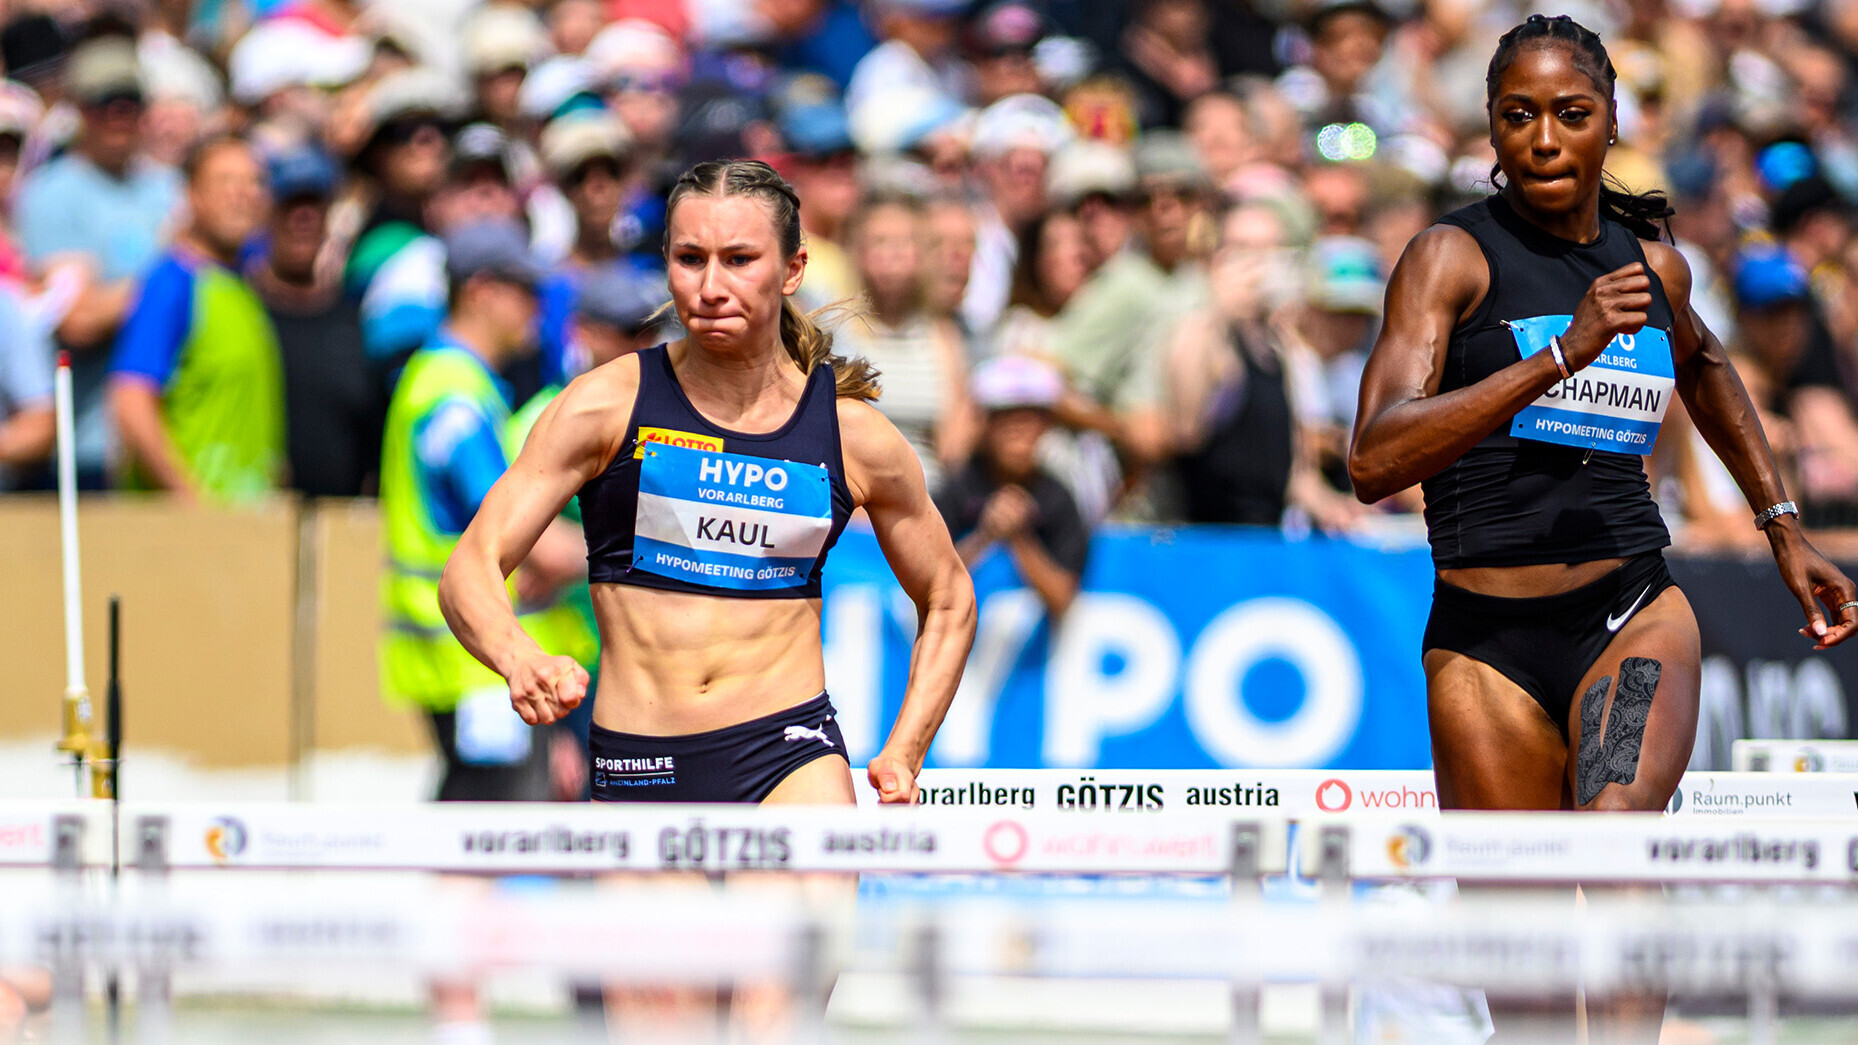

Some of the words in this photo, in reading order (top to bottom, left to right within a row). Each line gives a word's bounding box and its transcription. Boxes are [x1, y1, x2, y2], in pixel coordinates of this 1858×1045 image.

[1594, 354, 1637, 369] ARLBERG
[664, 435, 717, 452] LOTTO
[1536, 418, 1614, 440] HYPOMEETING
[1616, 429, 1647, 444] GÖTZIS
[699, 457, 788, 491] HYPO
[697, 488, 784, 509] VORARLBERG
[696, 516, 775, 549] KAUL
[656, 553, 754, 580] HYPOMEETING
[757, 566, 796, 580] GÖTZIS
[595, 756, 674, 771] SPORTHILFE
[918, 782, 1035, 809] orarlberg
[1057, 777, 1164, 812] GÖTZIS
[1186, 782, 1279, 806] austria
[1693, 790, 1792, 808] Raum.punkt
[659, 820, 792, 864] GÖTZIS
[825, 826, 937, 854] austria
